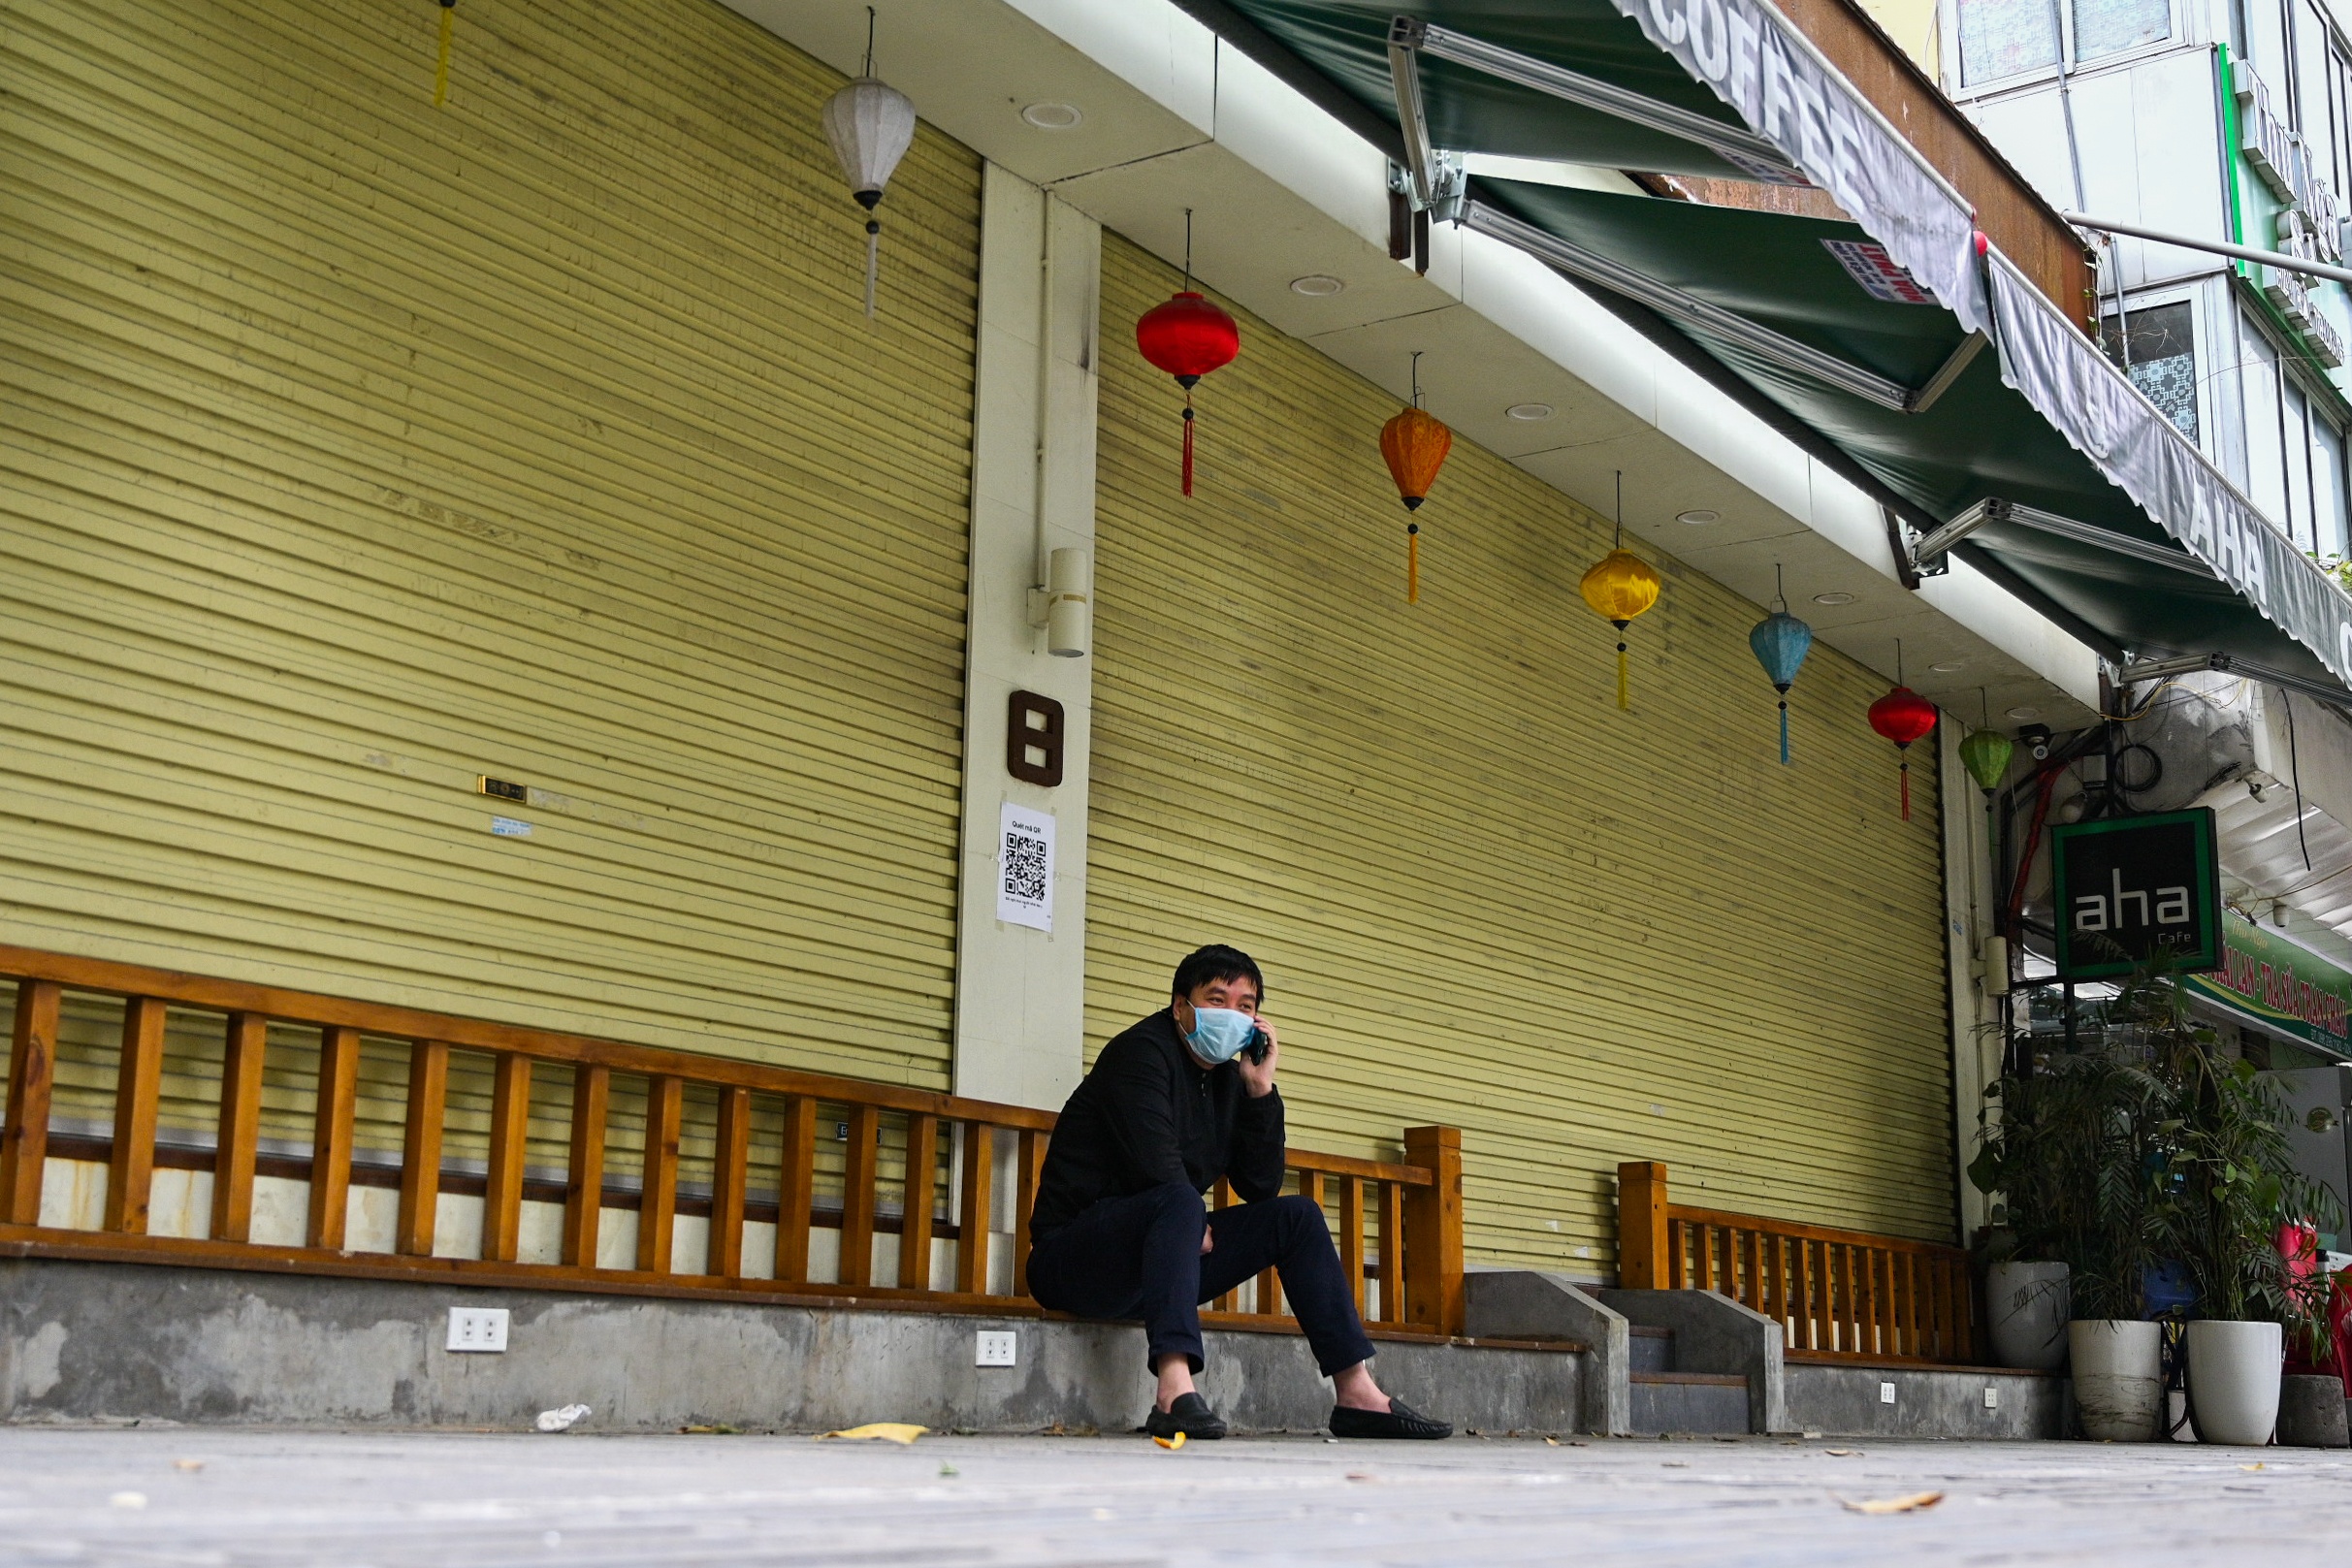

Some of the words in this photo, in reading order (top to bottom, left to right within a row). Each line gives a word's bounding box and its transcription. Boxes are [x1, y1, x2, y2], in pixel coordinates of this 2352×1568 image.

[2189, 482, 2268, 606] AHA
[1008, 689, 1064, 787] 8
[2076, 868, 2190, 931] aha
[2157, 932, 2191, 944] Cafe
